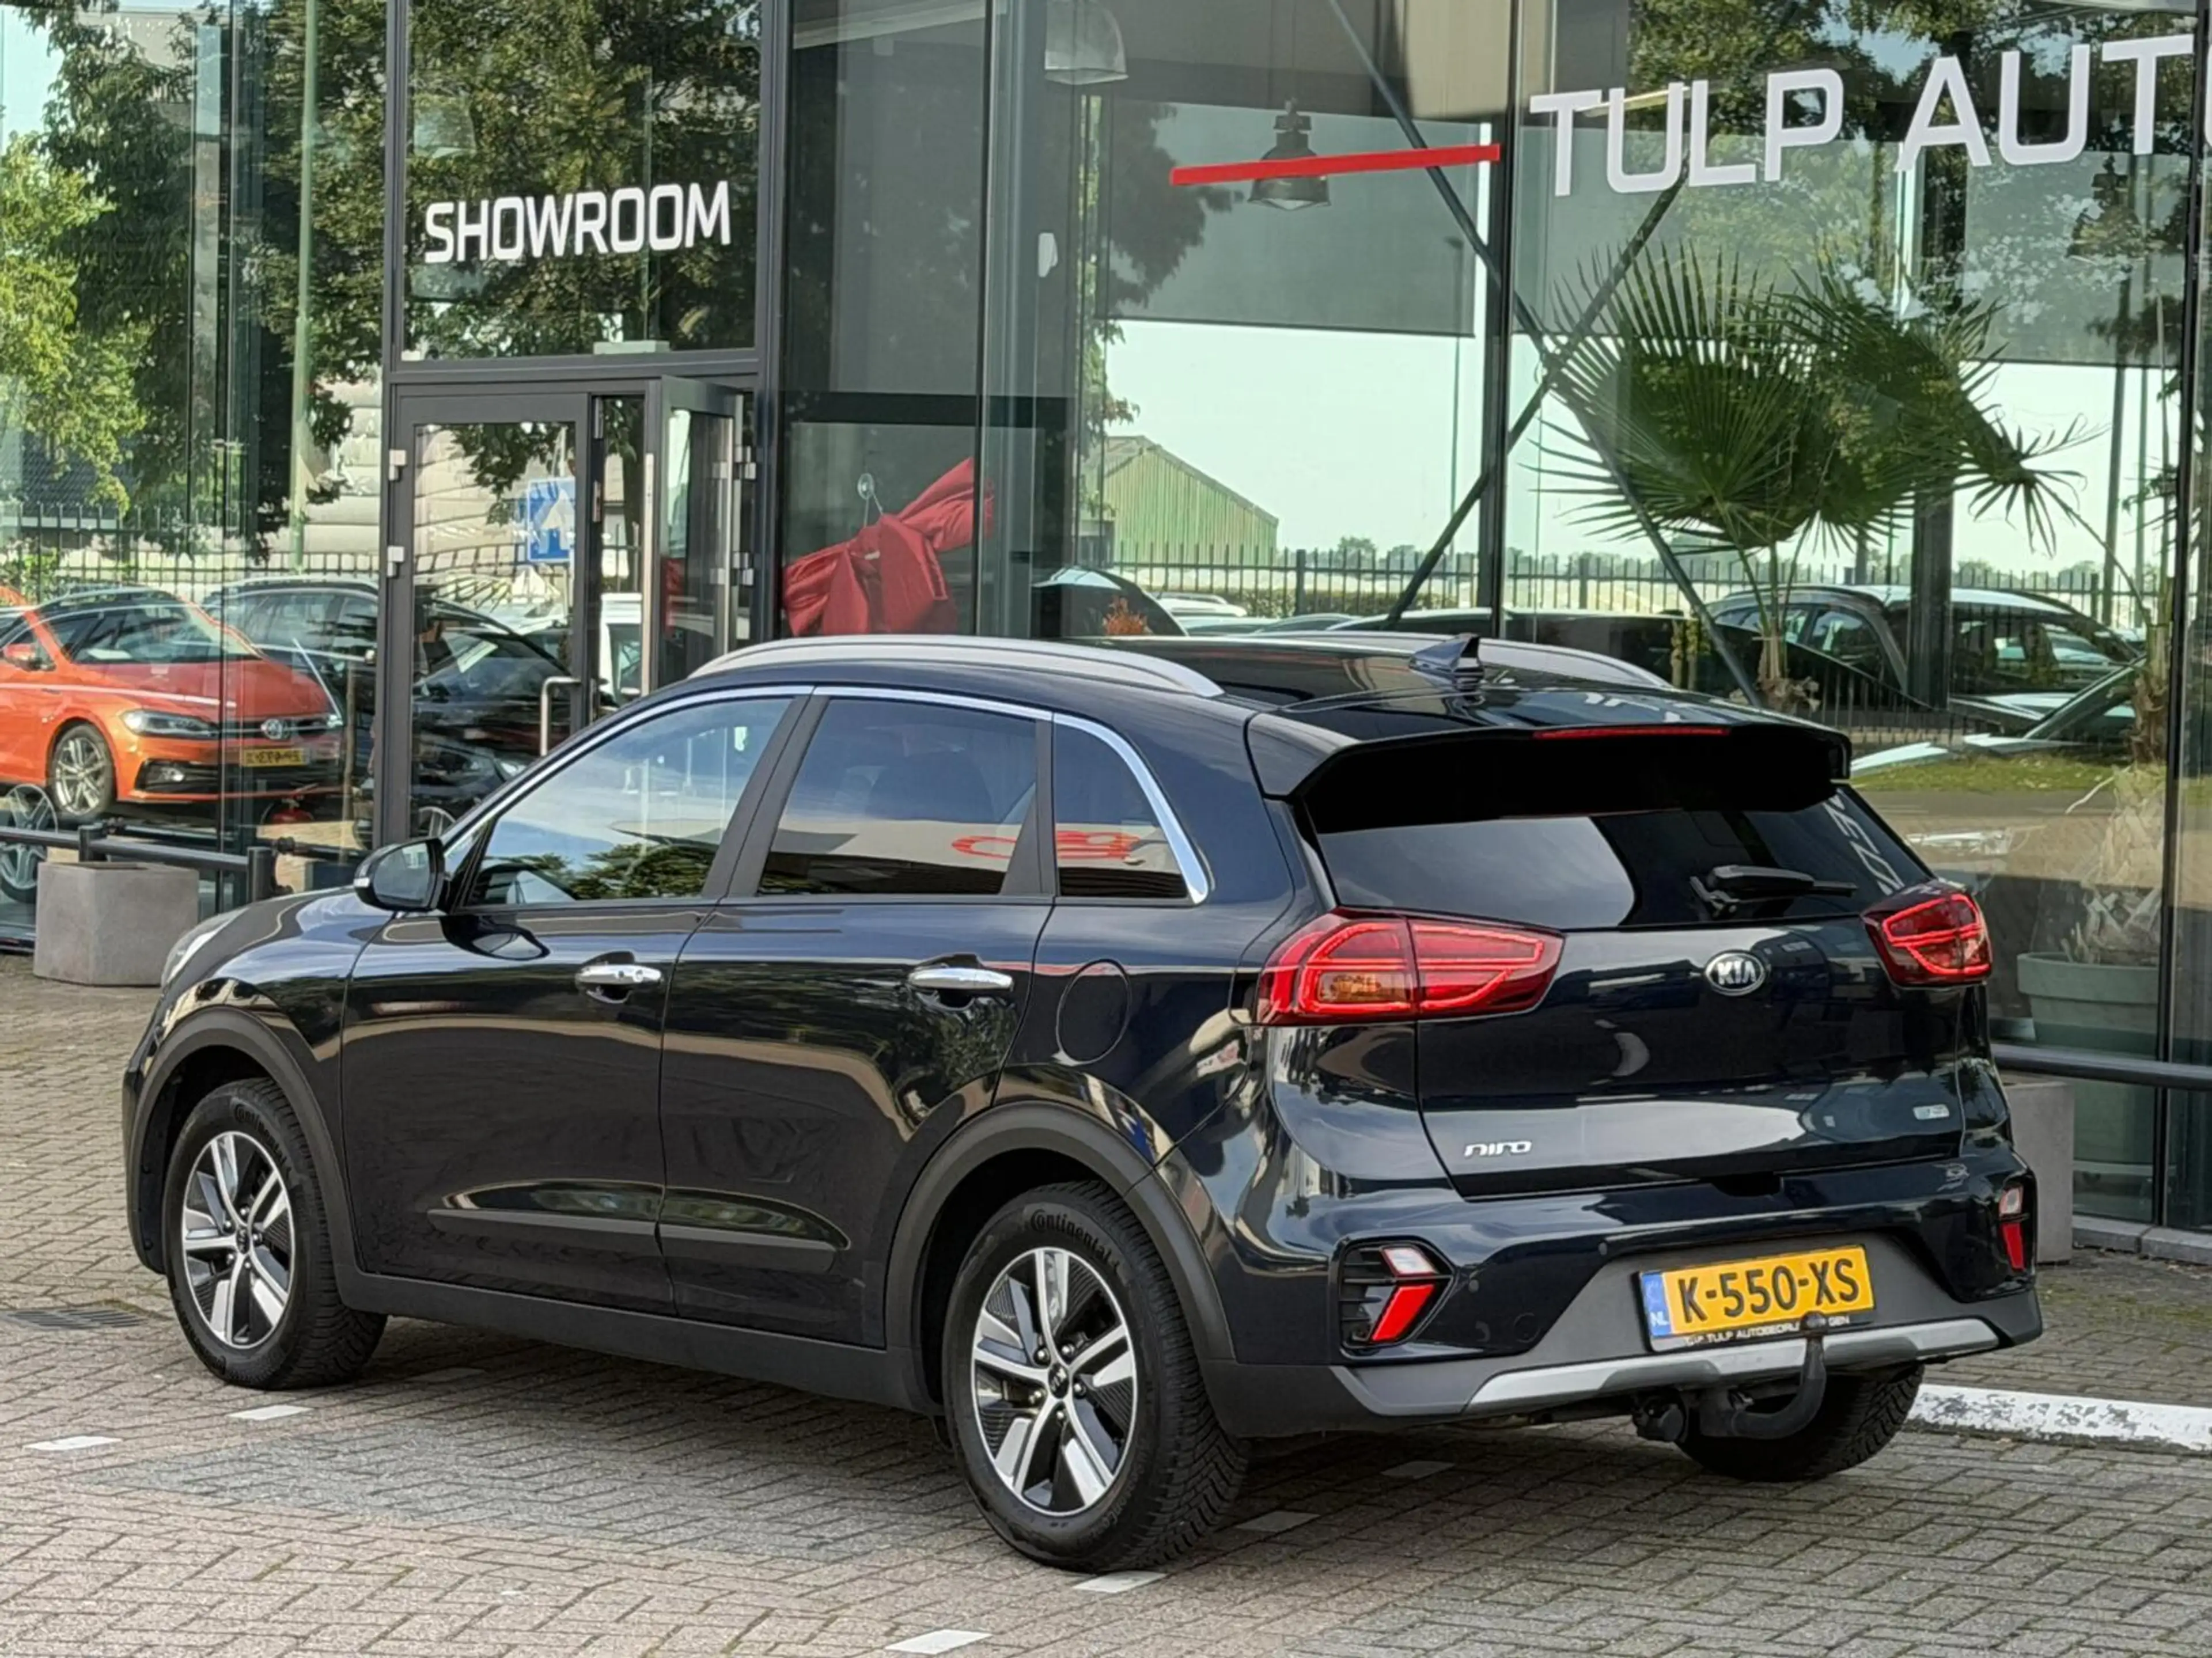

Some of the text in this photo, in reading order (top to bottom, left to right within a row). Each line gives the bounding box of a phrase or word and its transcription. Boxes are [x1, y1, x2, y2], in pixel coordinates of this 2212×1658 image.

[1529, 33, 2212, 197] TULP AUT
[424, 180, 731, 264] SHOWROOM
[1717, 960, 1756, 985] KIA
[1030, 1208, 1112, 1264] Continental
[1650, 1310, 1669, 1328] NL
[1677, 1258, 1860, 1323] K-550-XS
